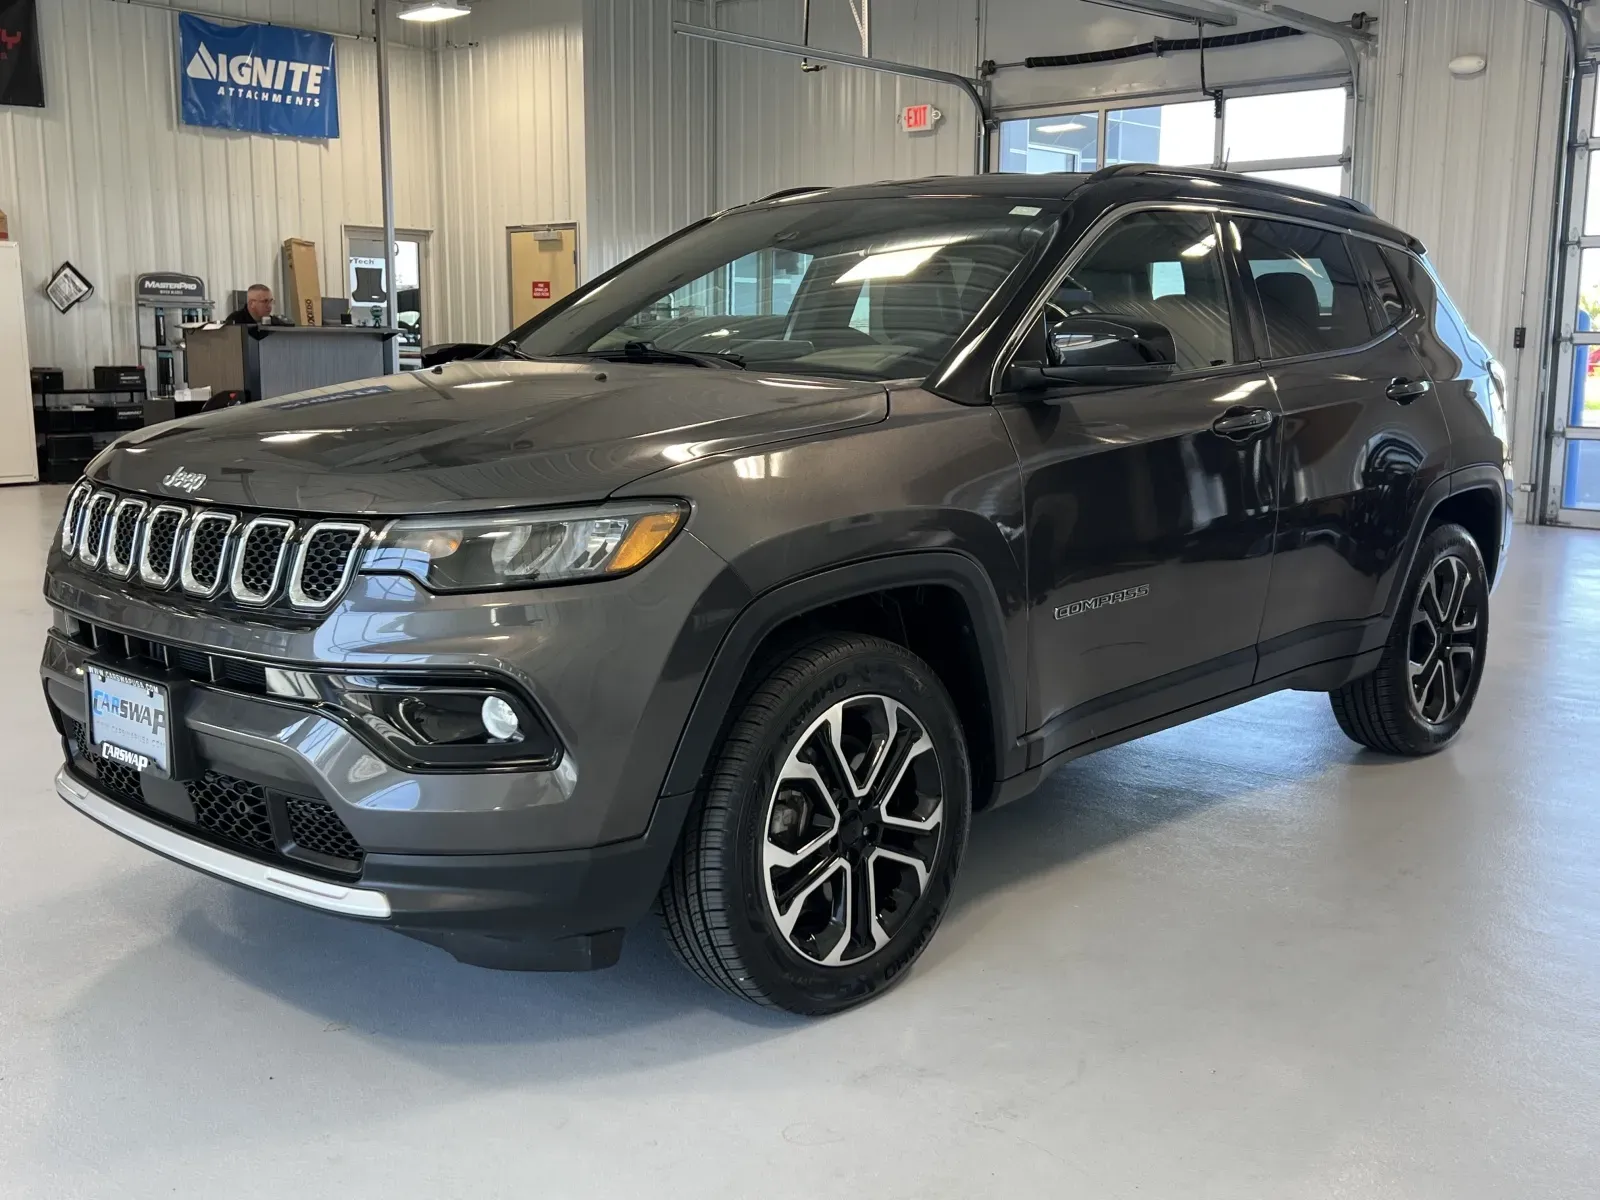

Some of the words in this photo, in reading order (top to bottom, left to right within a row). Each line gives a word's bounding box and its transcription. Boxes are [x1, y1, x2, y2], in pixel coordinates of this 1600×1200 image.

[218, 53, 323, 94] IGNITE
[217, 86, 320, 107] ATTACHMENTS
[907, 106, 928, 128] EXIT
[163, 466, 207, 493] Jeep
[1054, 584, 1150, 620] COMPASS
[93, 689, 165, 735] CARSWAP
[102, 742, 148, 771] CARSWAP
